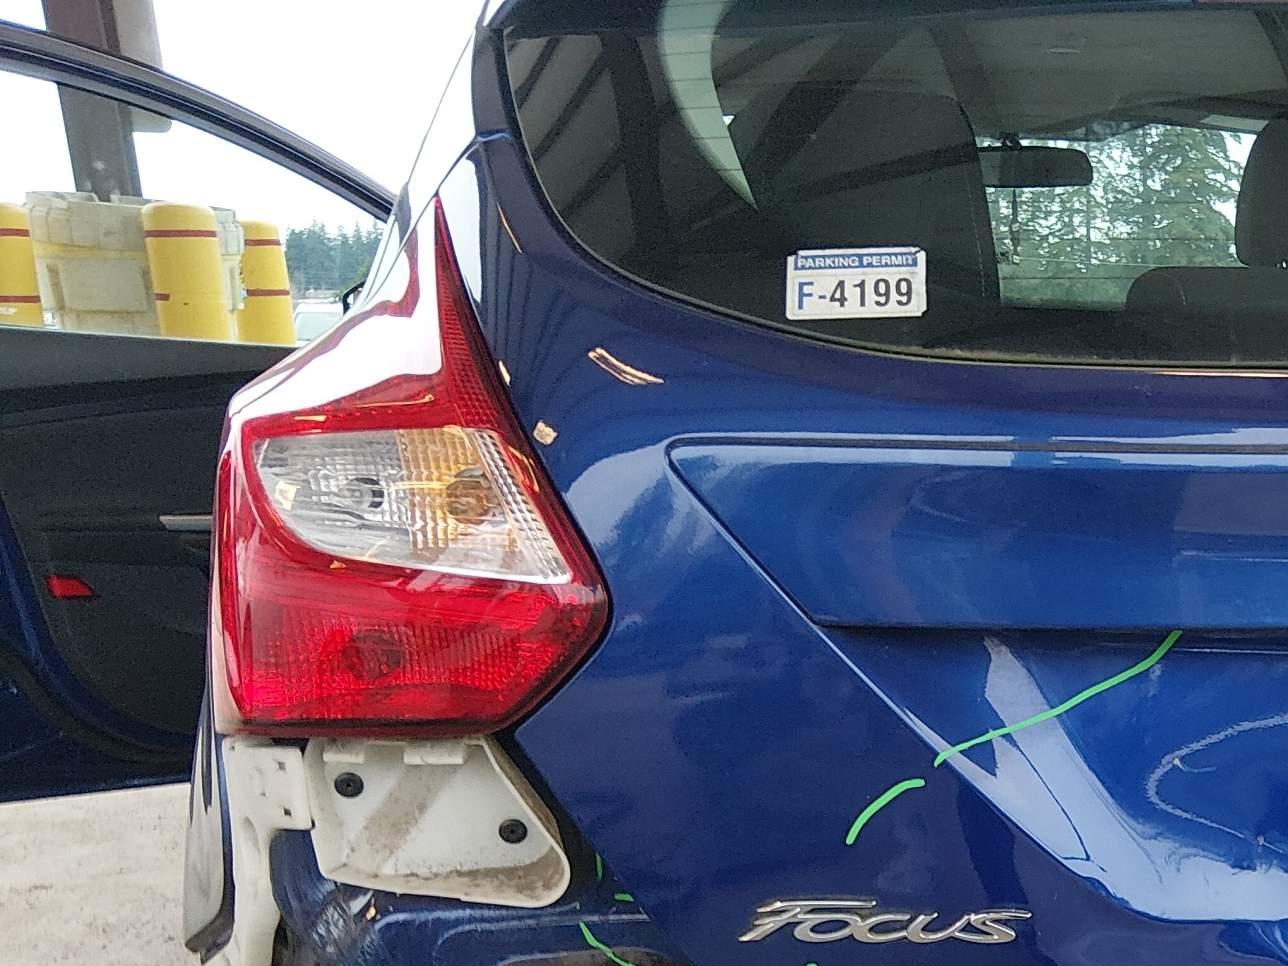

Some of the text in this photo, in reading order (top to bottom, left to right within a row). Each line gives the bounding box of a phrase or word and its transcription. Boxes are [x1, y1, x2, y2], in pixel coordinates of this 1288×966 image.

[797, 254, 915, 268] PARKING PERMIT
[797, 277, 913, 310] F-4199
